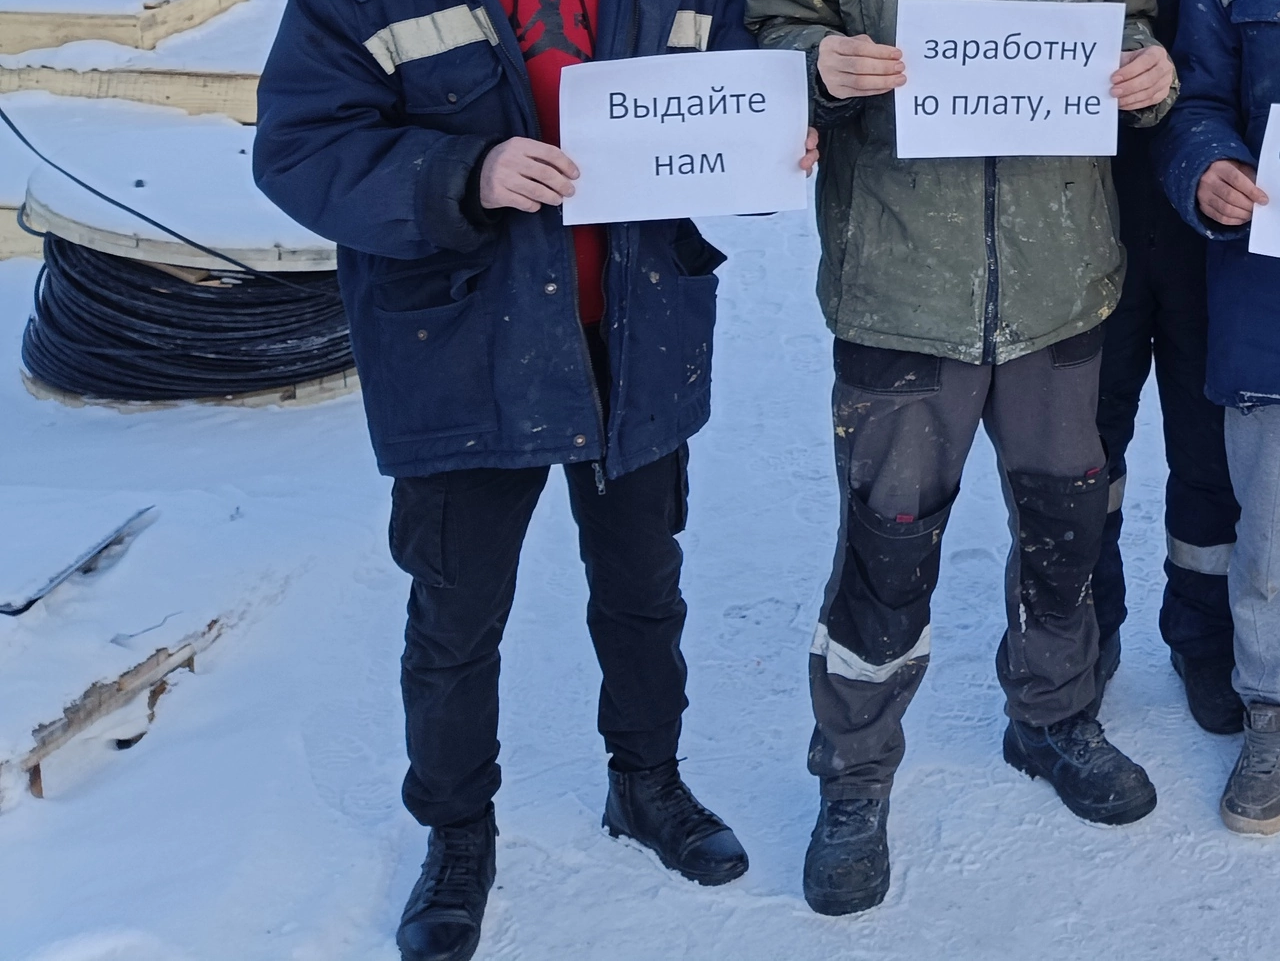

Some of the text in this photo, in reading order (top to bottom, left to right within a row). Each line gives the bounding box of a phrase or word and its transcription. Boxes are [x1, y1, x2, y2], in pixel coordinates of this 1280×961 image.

[923, 32, 1097, 68] заработну
[609, 86, 766, 124] Выдайте
[914, 93, 1101, 122] ю плату, не
[655, 152, 725, 176] нам
